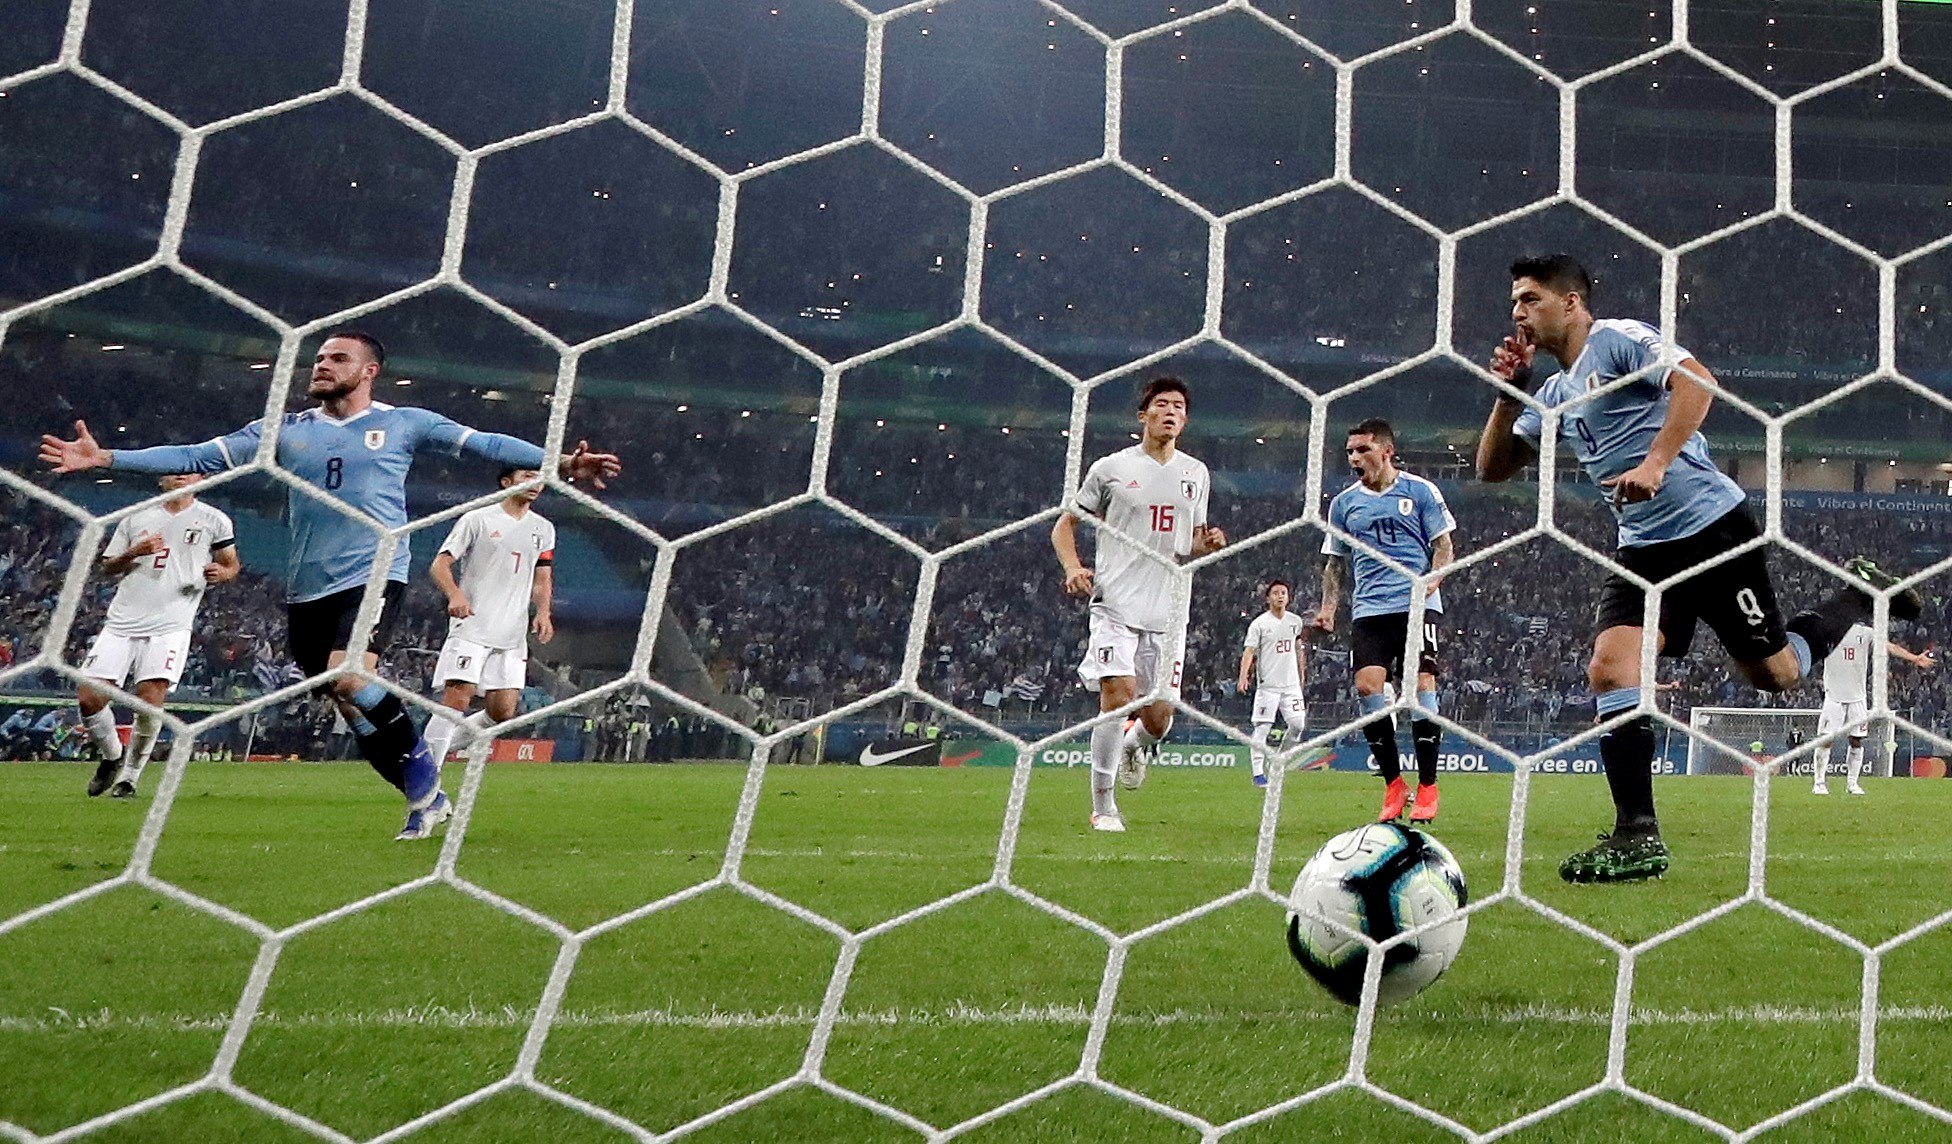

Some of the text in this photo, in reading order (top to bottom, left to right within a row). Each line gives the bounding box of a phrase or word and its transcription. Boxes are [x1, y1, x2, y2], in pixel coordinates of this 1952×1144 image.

[1576, 417, 1597, 455] 9
[326, 457, 342, 489] 8
[1817, 497, 1855, 510] Vibra
[1860, 497, 1872, 510] el
[1149, 505, 1174, 532] 16
[1367, 517, 1397, 545] 14
[154, 548, 170, 569] 2
[511, 551, 521, 574] 7
[1276, 640, 1291, 653] 20
[1843, 647, 1855, 661] 18
[1530, 758, 1568, 773] ree
[1572, 758, 1598, 773] en
